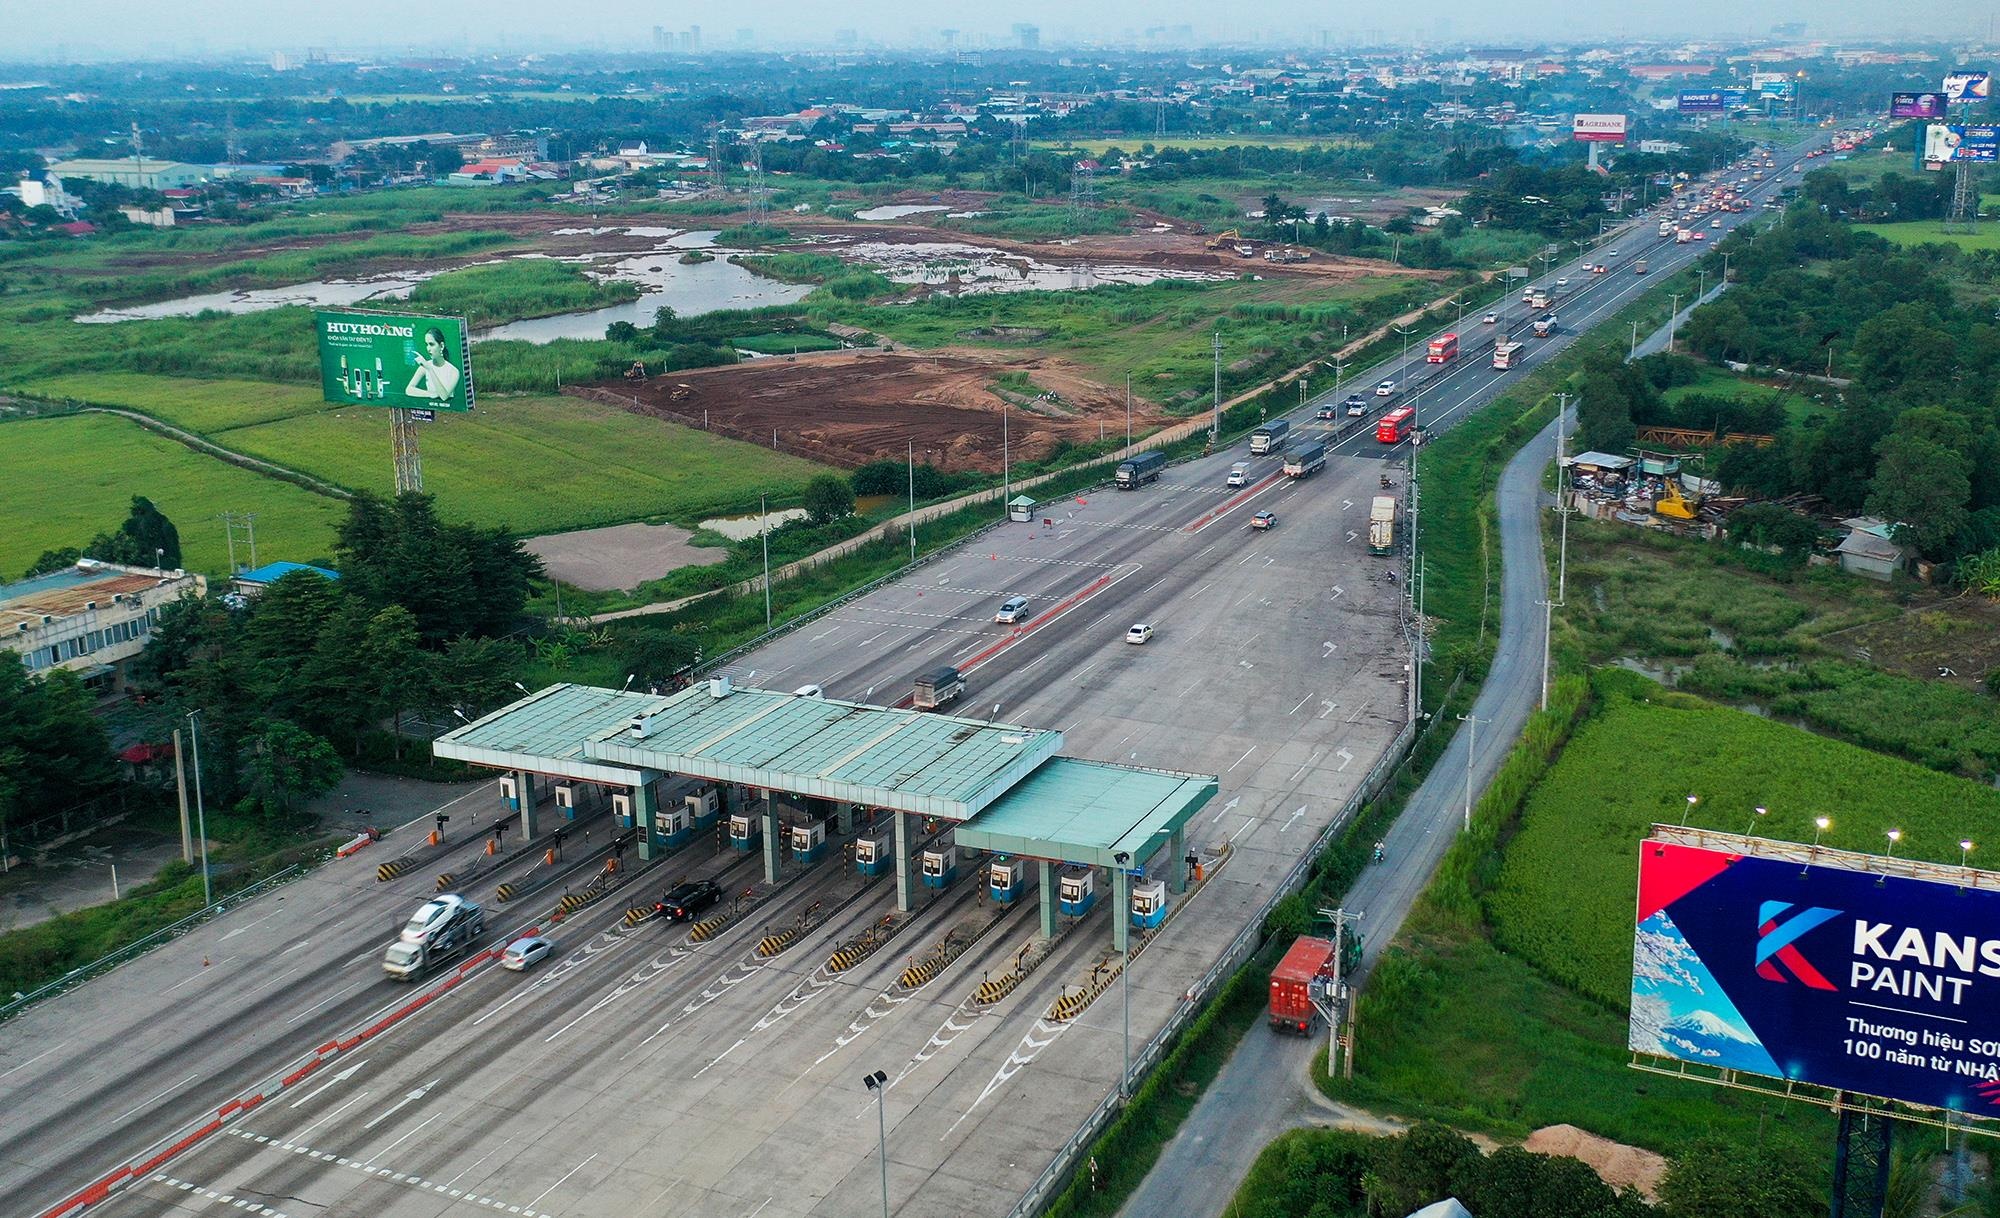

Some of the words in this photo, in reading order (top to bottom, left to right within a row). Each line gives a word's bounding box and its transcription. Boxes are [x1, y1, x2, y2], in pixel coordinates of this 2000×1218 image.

[1851, 961, 1972, 1005] PAINT
[1846, 1017, 1918, 1046] Thương
[1922, 1029, 1964, 1052] hiệu
[1968, 1037, 2000, 1058] SƠ
[1843, 1039, 1881, 1059] 100
[1885, 1048, 1927, 1068] năm
[1930, 1055, 1952, 1072] từ
[1955, 1059, 2000, 1083] NHẬ
